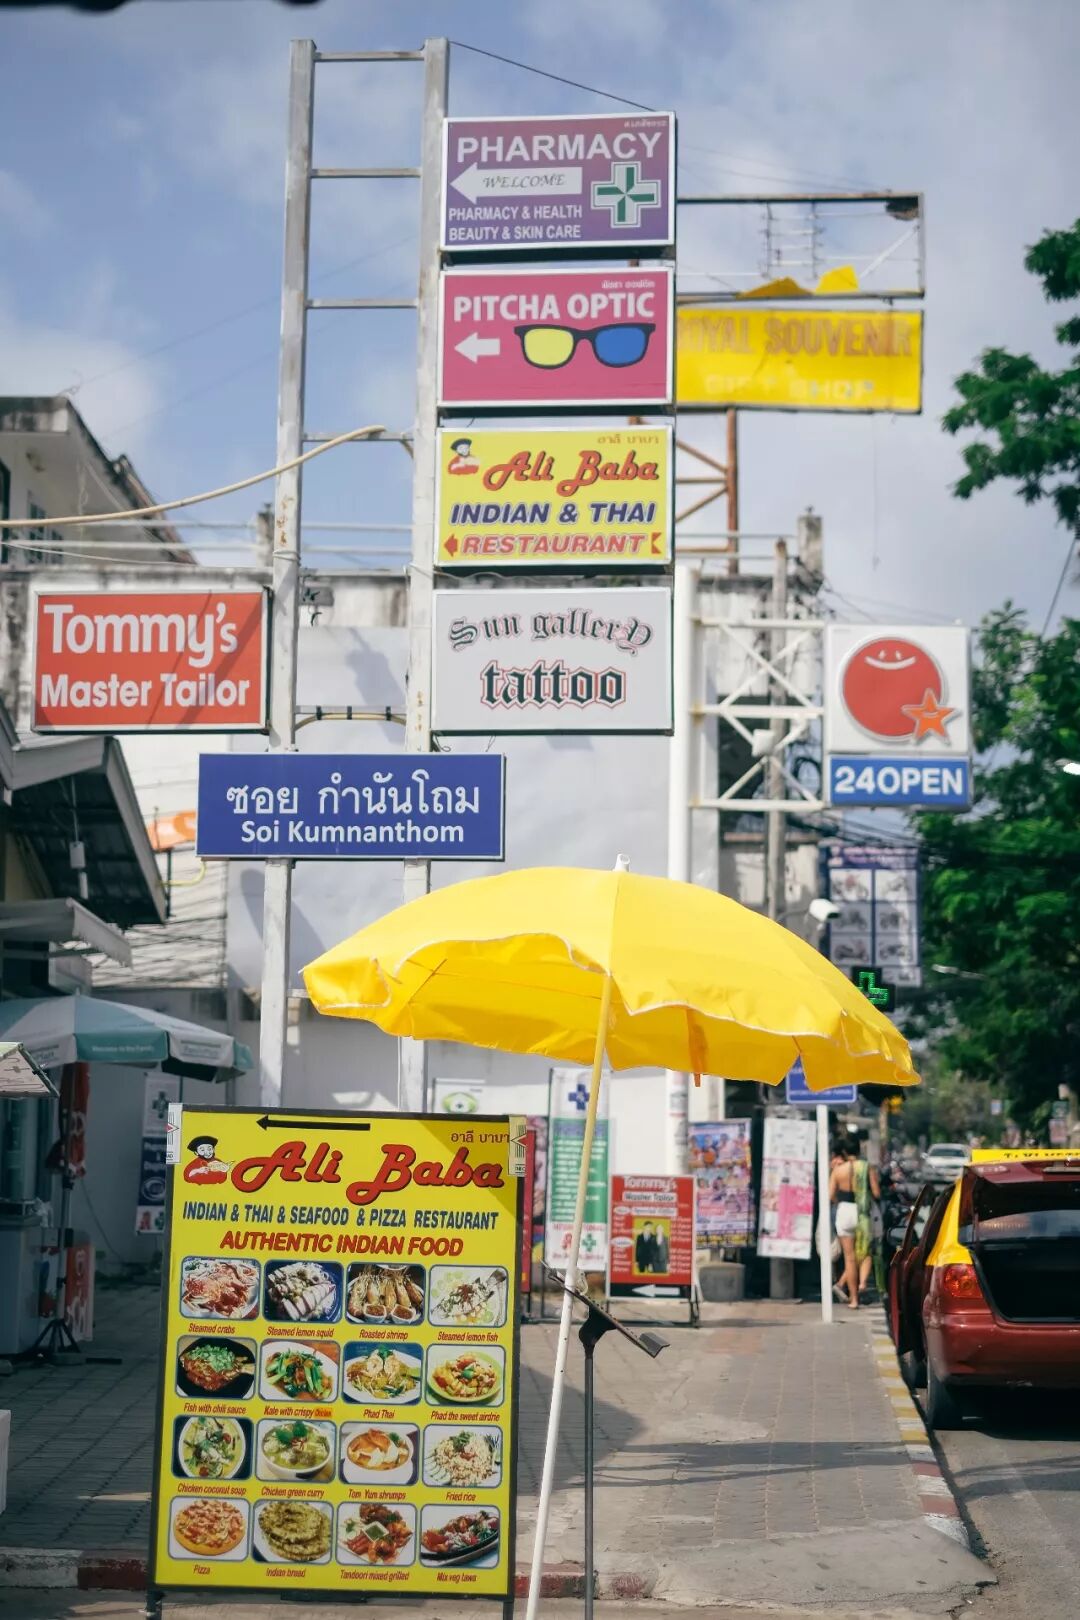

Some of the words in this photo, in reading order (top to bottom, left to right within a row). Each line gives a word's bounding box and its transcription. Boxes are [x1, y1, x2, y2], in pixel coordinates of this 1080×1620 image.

[457, 132, 662, 163] PHARMACY
[483, 173, 566, 188] WELCOME
[449, 206, 519, 221] PHARMACY
[522, 206, 531, 219] &
[534, 205, 582, 219] HEALTH
[449, 226, 499, 241] BEAUTY
[502, 226, 511, 240] &
[514, 226, 543, 240] SKIN
[546, 225, 581, 238] CARE
[453, 295, 560, 322] PITCHA
[567, 292, 655, 318] OPTIC
[765, 317, 911, 357] SOUVENIR
[482, 450, 554, 491] Ali
[556, 449, 660, 497] Baba
[450, 503, 550, 524] INDIAN
[559, 503, 578, 523] &
[590, 502, 656, 522] THAI
[462, 534, 645, 555] RESTAURANT
[43, 602, 238, 668] Tommy's
[448, 614, 521, 651] Sun
[41, 674, 152, 708] Master
[160, 673, 250, 706] Tailor
[480, 660, 626, 709] tattoo
[226, 784, 299, 815] ซอย
[318, 769, 480, 815] กำนันโถม
[241, 820, 280, 843] Soi
[288, 819, 464, 843] Kumnanthom
[451, 1130, 474, 1143] อาลี
[231, 1141, 343, 1193] Ali
[346, 1144, 505, 1206] Baba
[183, 1201, 226, 1221] INDIAN
[230, 1204, 239, 1222] &
[245, 1204, 273, 1223] THAI
[278, 1206, 286, 1224] &
[290, 1207, 349, 1226] SEAFOOD
[356, 1209, 365, 1226] &
[369, 1209, 407, 1228] PIZZA
[414, 1210, 499, 1230] RESTAURANT
[220, 1231, 332, 1253] AUTHENTIC
[336, 1234, 405, 1255] INDIAN
[408, 1237, 463, 1256] FOOD
[189, 1323, 217, 1333] Steamed
[217, 1325, 235, 1334] crabs
[267, 1326, 295, 1336] Steamed
[296, 1328, 316, 1336] lemon
[316, 1328, 335, 1339] squid
[359, 1329, 386, 1339] Roasted
[438, 1331, 466, 1341] Steamed
[466, 1332, 486, 1341] lemon
[487, 1332, 499, 1342] fish
[184, 1403, 197, 1412] Fish
[198, 1404, 212, 1413] with
[227, 1406, 247, 1414] sauce
[264, 1405, 279, 1415] Kale
[280, 1407, 293, 1416] with
[294, 1407, 314, 1418] crispy
[363, 1409, 380, 1419] Phad
[382, 1409, 395, 1419] Thai
[460, 1412, 479, 1421] sweet
[177, 1482, 203, 1493] Chicken
[204, 1485, 231, 1494] coconut
[231, 1487, 247, 1496] soup
[261, 1486, 287, 1496] Chicken
[287, 1488, 307, 1498] green
[307, 1489, 325, 1499] curry
[348, 1489, 361, 1498] Tom
[364, 1489, 378, 1499] Yum
[446, 1491, 463, 1501] Fried
[464, 1493, 476, 1501] rice
[193, 1564, 211, 1575] Pizza
[266, 1567, 286, 1577] Indian
[286, 1568, 306, 1577] bread
[340, 1569, 368, 1580] Tandoori
[369, 1571, 389, 1580] mixed
[389, 1571, 410, 1582] grilled
[437, 1571, 449, 1581] Mix
[449, 1574, 460, 1584] veg
